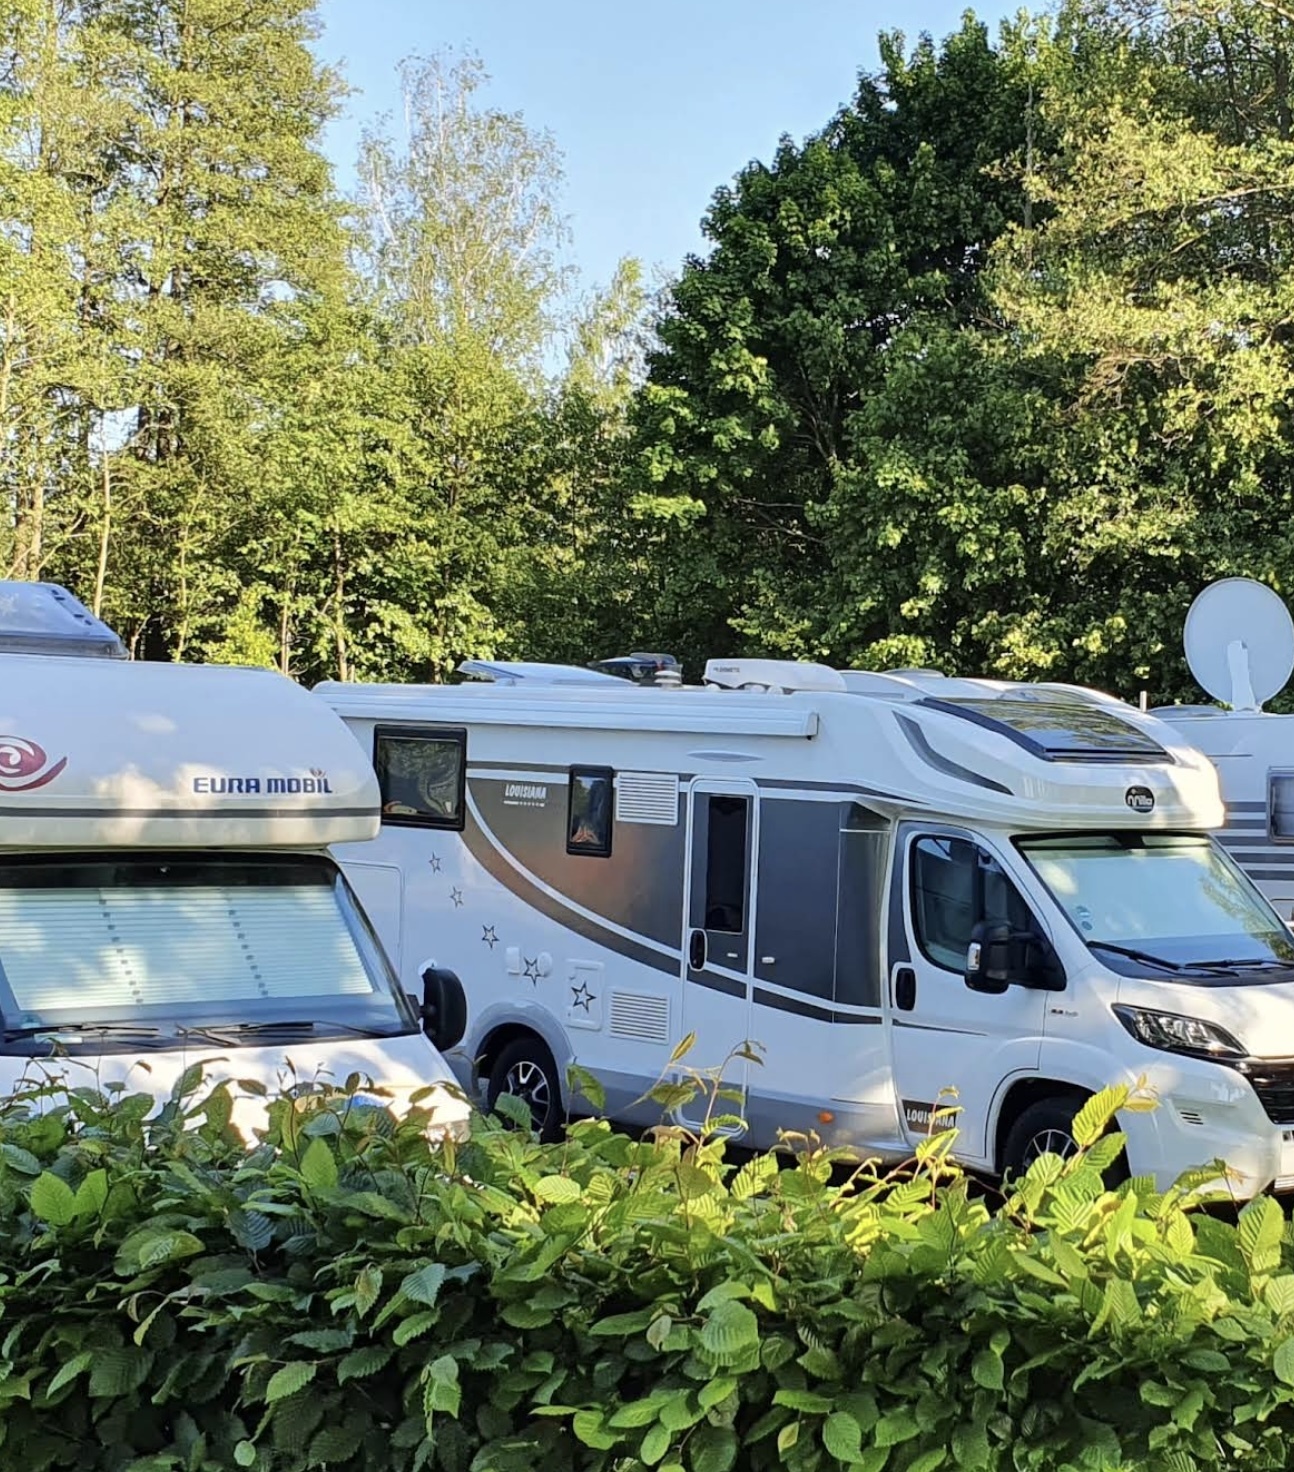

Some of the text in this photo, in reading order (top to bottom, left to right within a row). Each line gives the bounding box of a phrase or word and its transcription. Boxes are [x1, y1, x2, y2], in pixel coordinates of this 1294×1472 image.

[193, 776, 333, 794] EURA MOBIL
[505, 784, 547, 799] LOUISIANA
